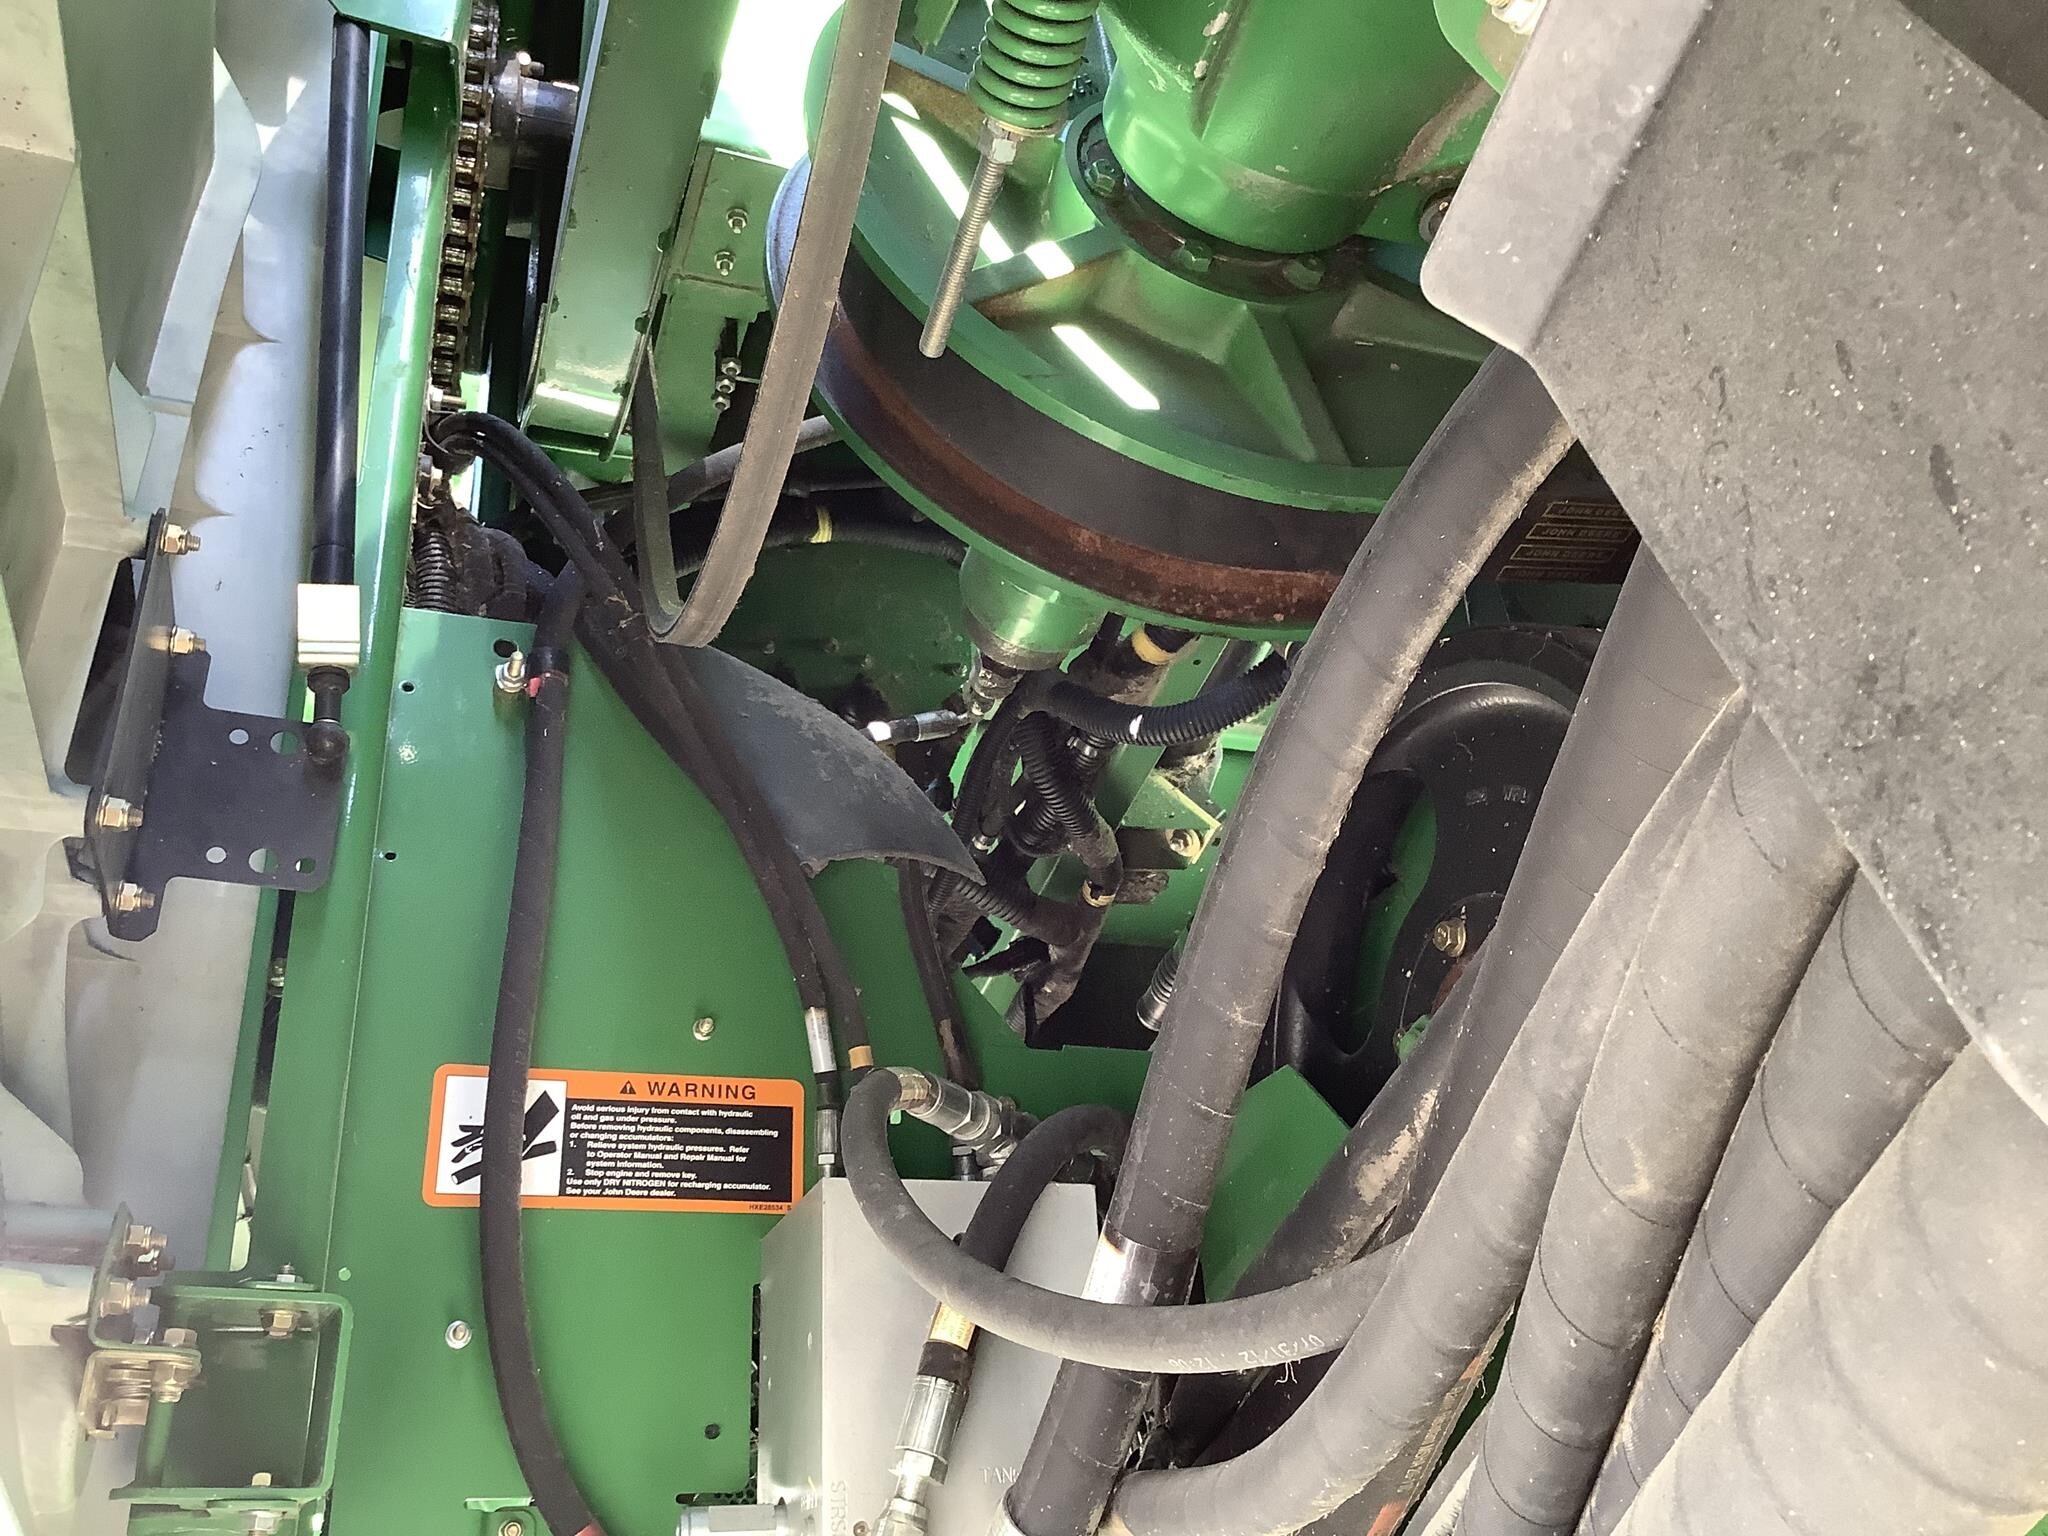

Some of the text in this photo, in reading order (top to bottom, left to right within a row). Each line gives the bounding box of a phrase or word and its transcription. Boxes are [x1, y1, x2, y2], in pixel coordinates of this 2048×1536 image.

[648, 1081, 756, 1099] WARNING
[596, 1105, 625, 1113] serious
[627, 1106, 649, 1115] injury
[671, 1108, 699, 1116] contact
[719, 1110, 753, 1118] hydraulic
[570, 1122, 778, 1137] Before removing hydraulic components, disassembling
[580, 1132, 617, 1140] changing
[619, 1133, 674, 1141] accumulators:
[648, 1143, 683, 1151] hydraulic
[597, 1151, 632, 1159] Operator
[634, 1151, 662, 1159] Manual
[680, 1153, 705, 1161] Repair
[585, 1169, 604, 1177] Stop
[606, 1170, 633, 1178] engine
[584, 1178, 601, 1186] only
[623, 1179, 666, 1187] NITROGEN
[681, 1181, 721, 1190] recharging
[831, 1480, 848, 1536] STRS
